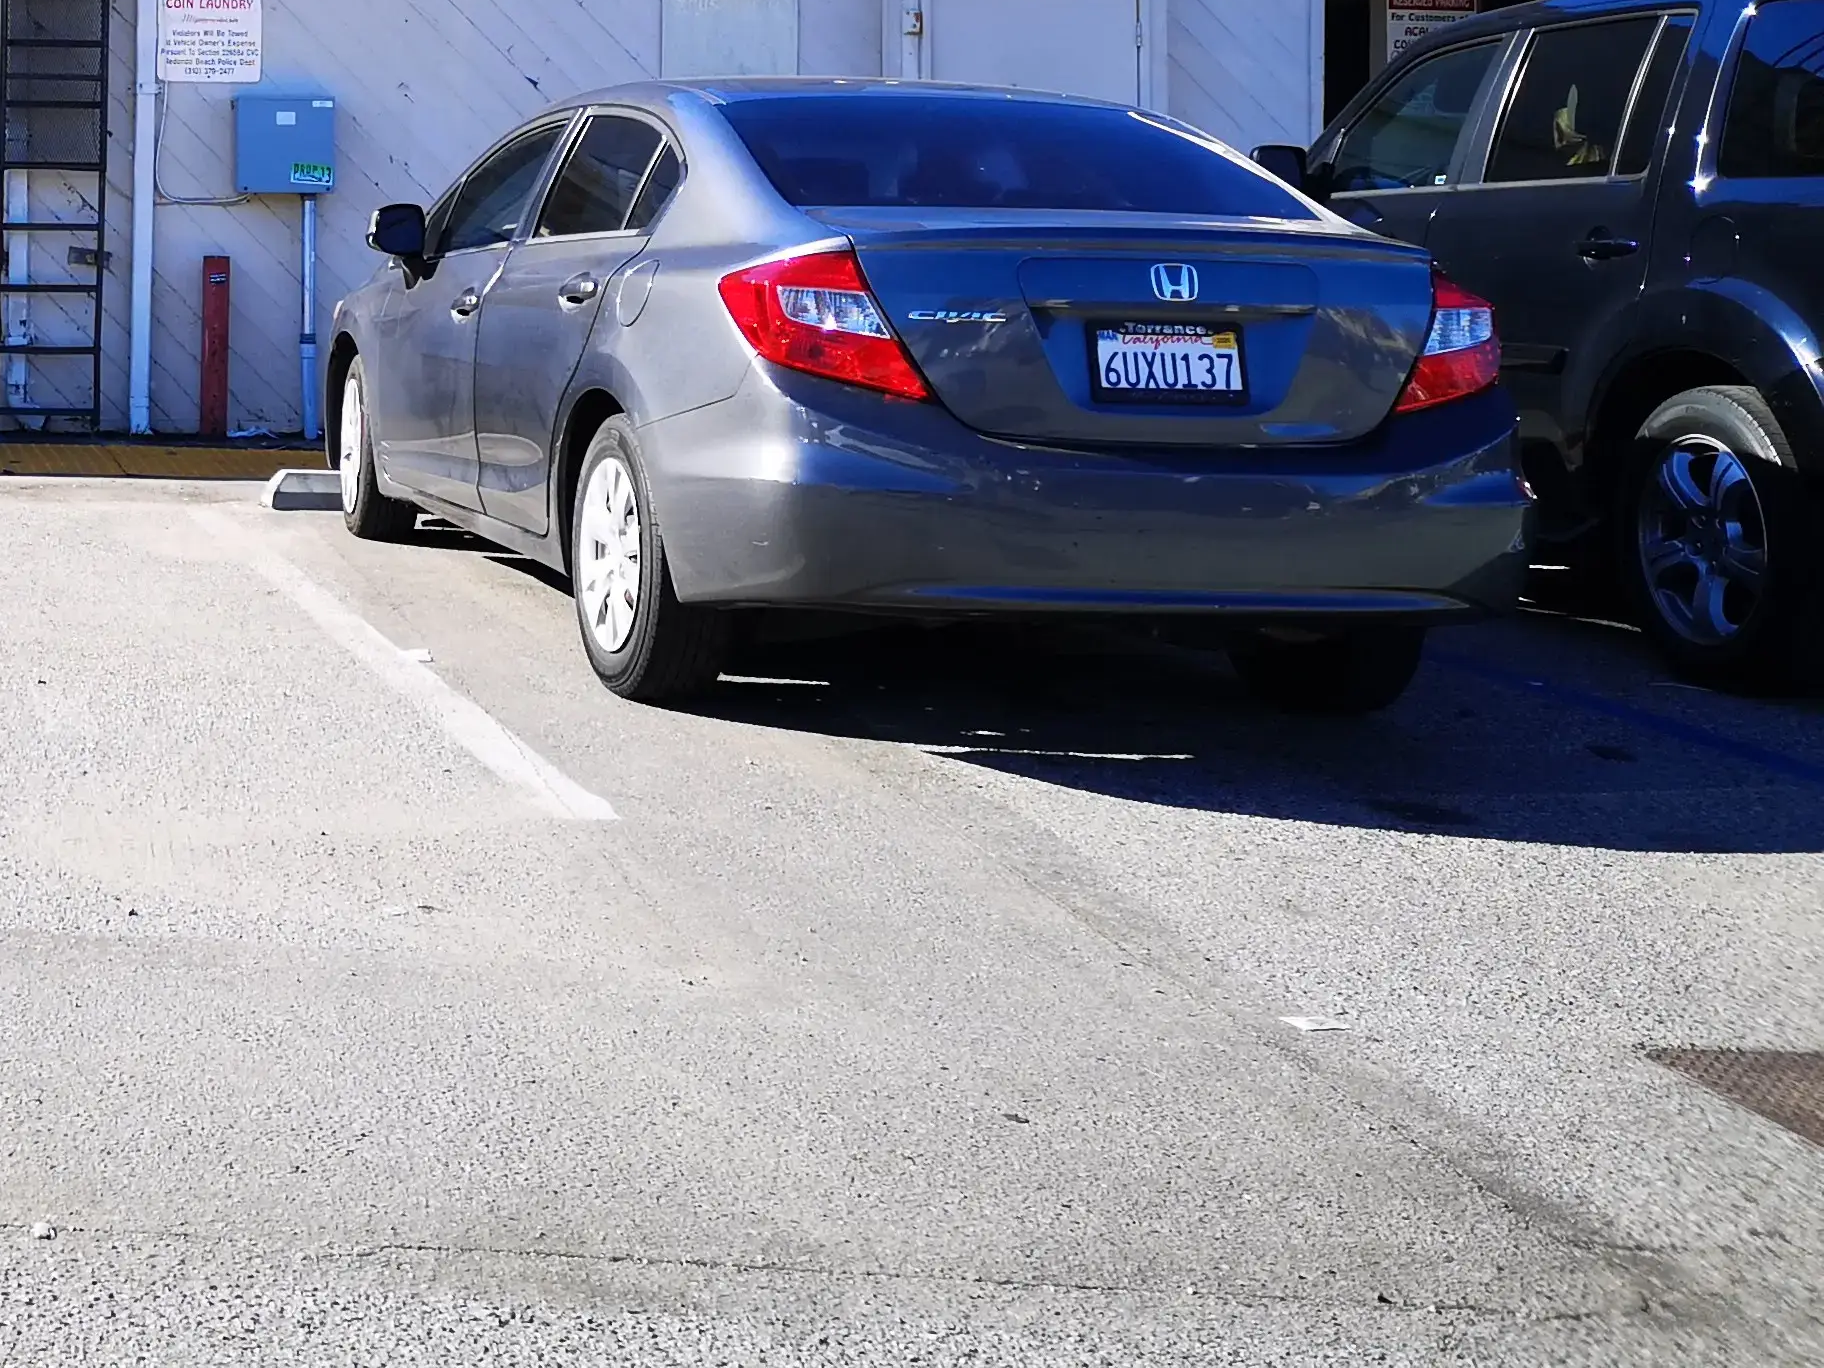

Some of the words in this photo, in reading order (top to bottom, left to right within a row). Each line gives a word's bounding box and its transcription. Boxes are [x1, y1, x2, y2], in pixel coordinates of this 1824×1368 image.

[1391, 12, 1405, 21] For
[1408, 12, 1456, 23] Customers
[1124, 321, 1207, 335] Torrance
[1104, 351, 1234, 390] 6UXU137
